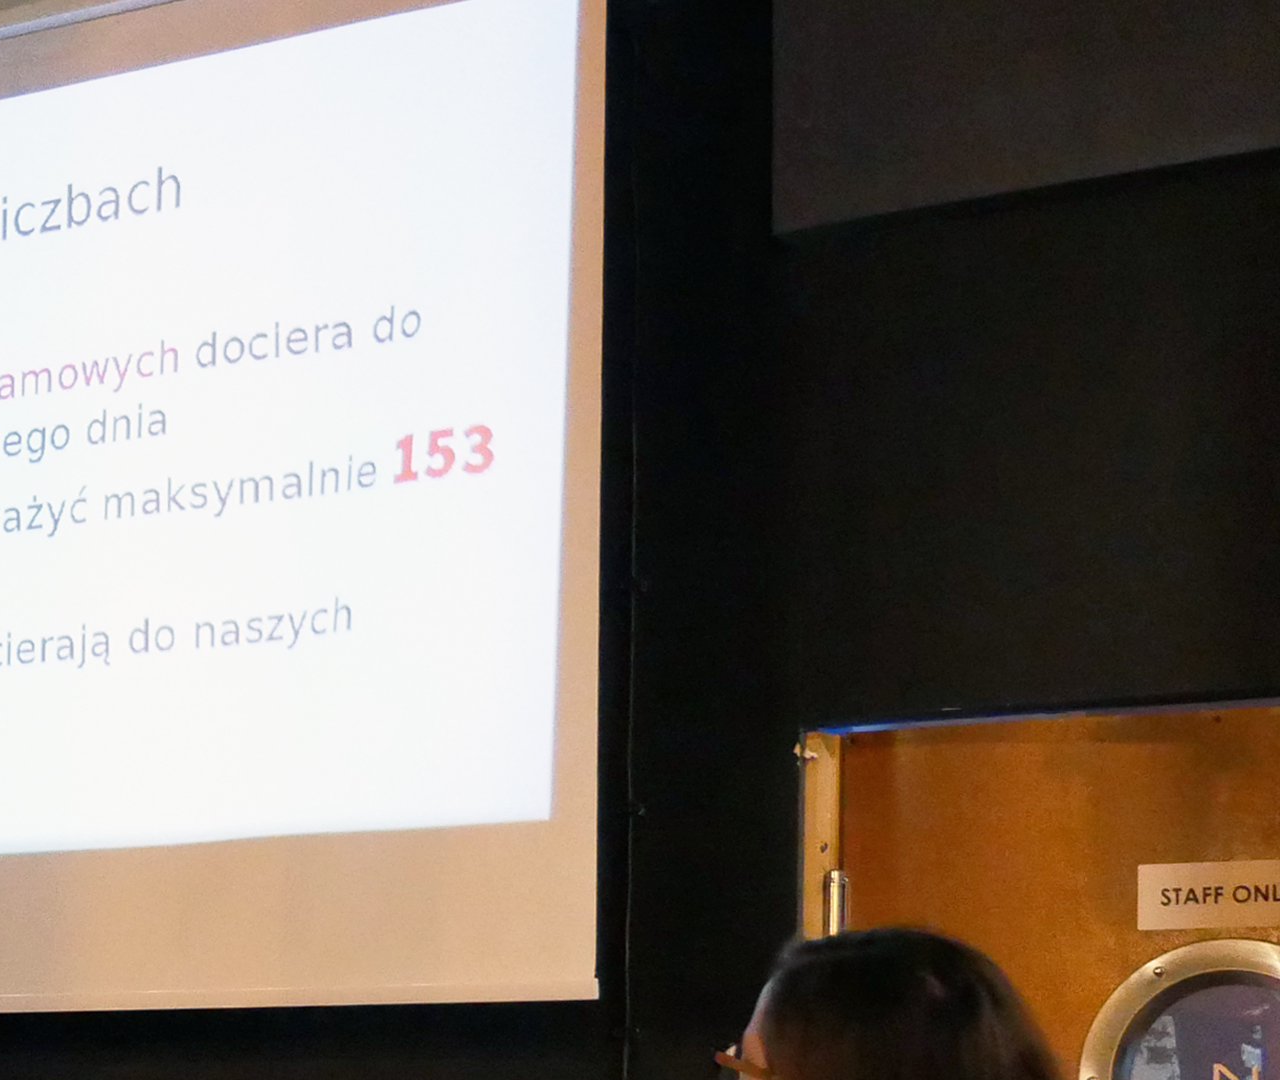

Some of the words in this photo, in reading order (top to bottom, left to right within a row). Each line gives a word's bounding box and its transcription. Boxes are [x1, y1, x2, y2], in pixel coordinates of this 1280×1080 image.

[195, 321, 353, 369] dociera
[372, 305, 422, 344] do
[86, 404, 167, 446] dnia
[104, 458, 377, 520] maksymalnie
[393, 424, 495, 484] 153
[128, 617, 175, 654] do
[195, 597, 352, 650] naszych
[1160, 886, 1224, 906] STAFF
